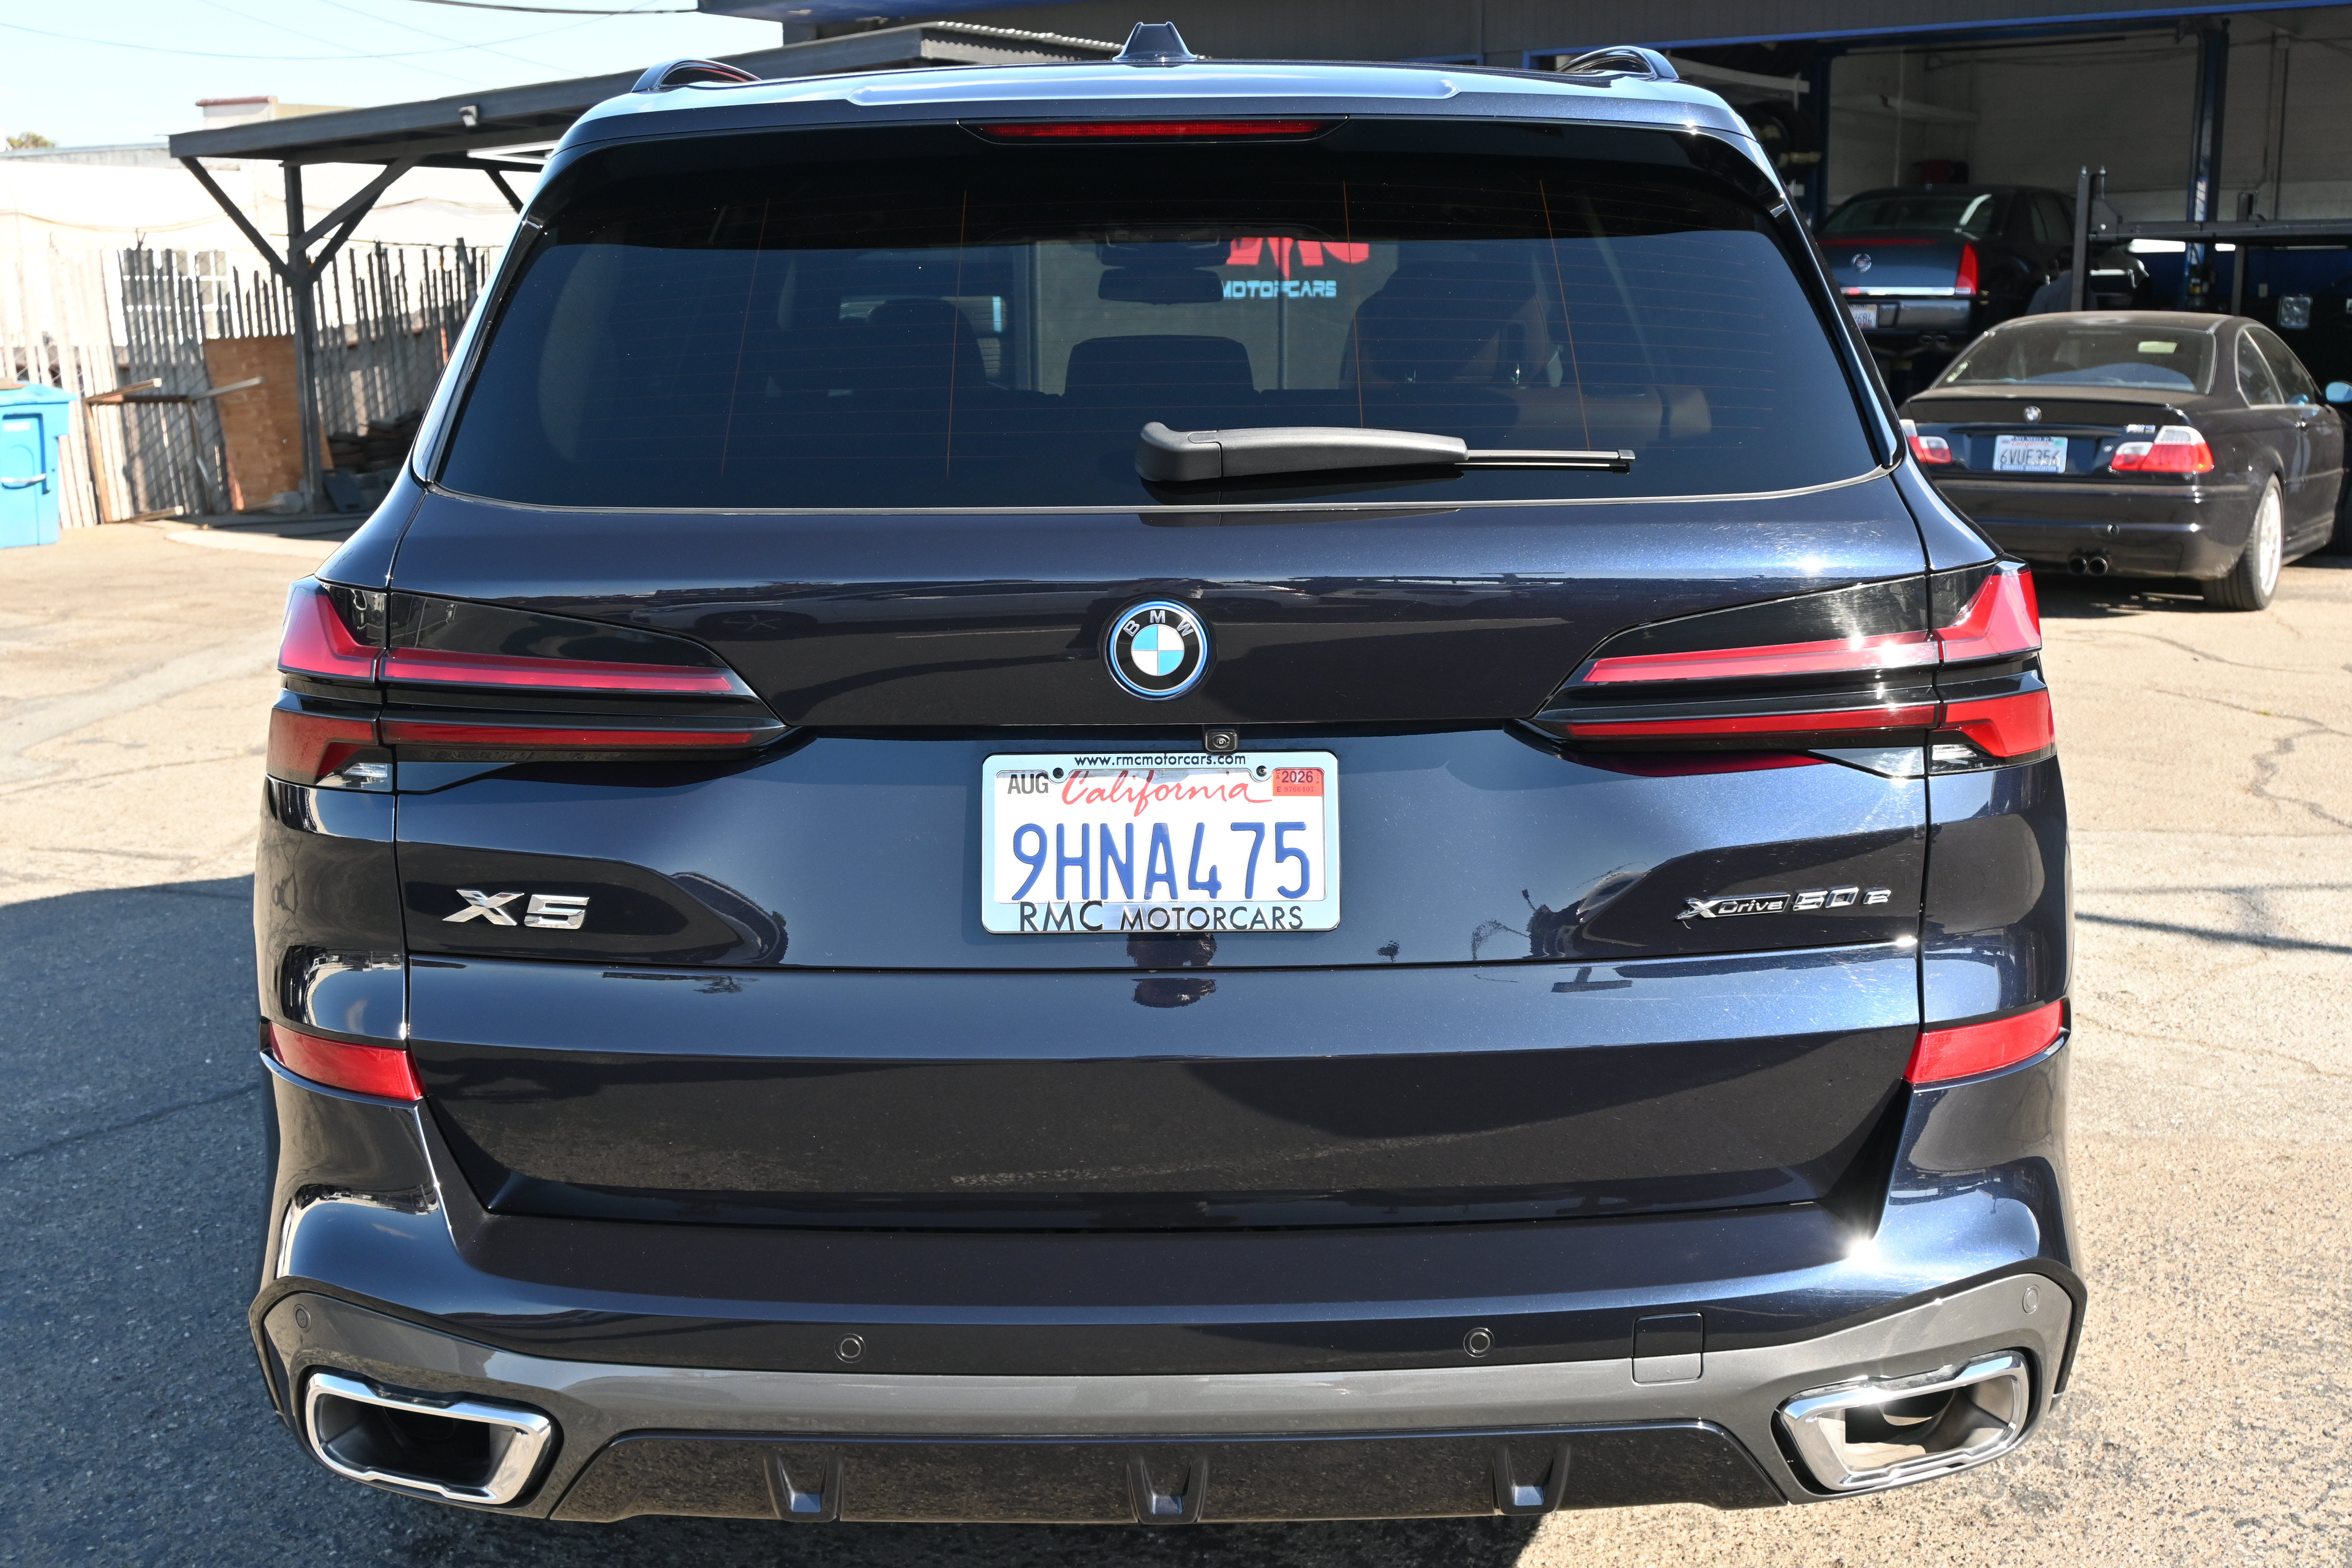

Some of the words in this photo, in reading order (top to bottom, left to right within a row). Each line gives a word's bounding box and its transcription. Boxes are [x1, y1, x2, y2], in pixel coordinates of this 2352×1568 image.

[1123, 610, 1194, 637] BMW
[1074, 753, 1246, 765] www.rmcmotorcars.com
[1007, 773, 1049, 794] AUG
[1282, 770, 1313, 783] 2026
[1062, 770, 1272, 817] California
[1012, 822, 1310, 900] 9HNA475
[442, 889, 590, 929] X5
[1020, 900, 1104, 931] RMC
[1120, 905, 1303, 931] MOTORCARS
